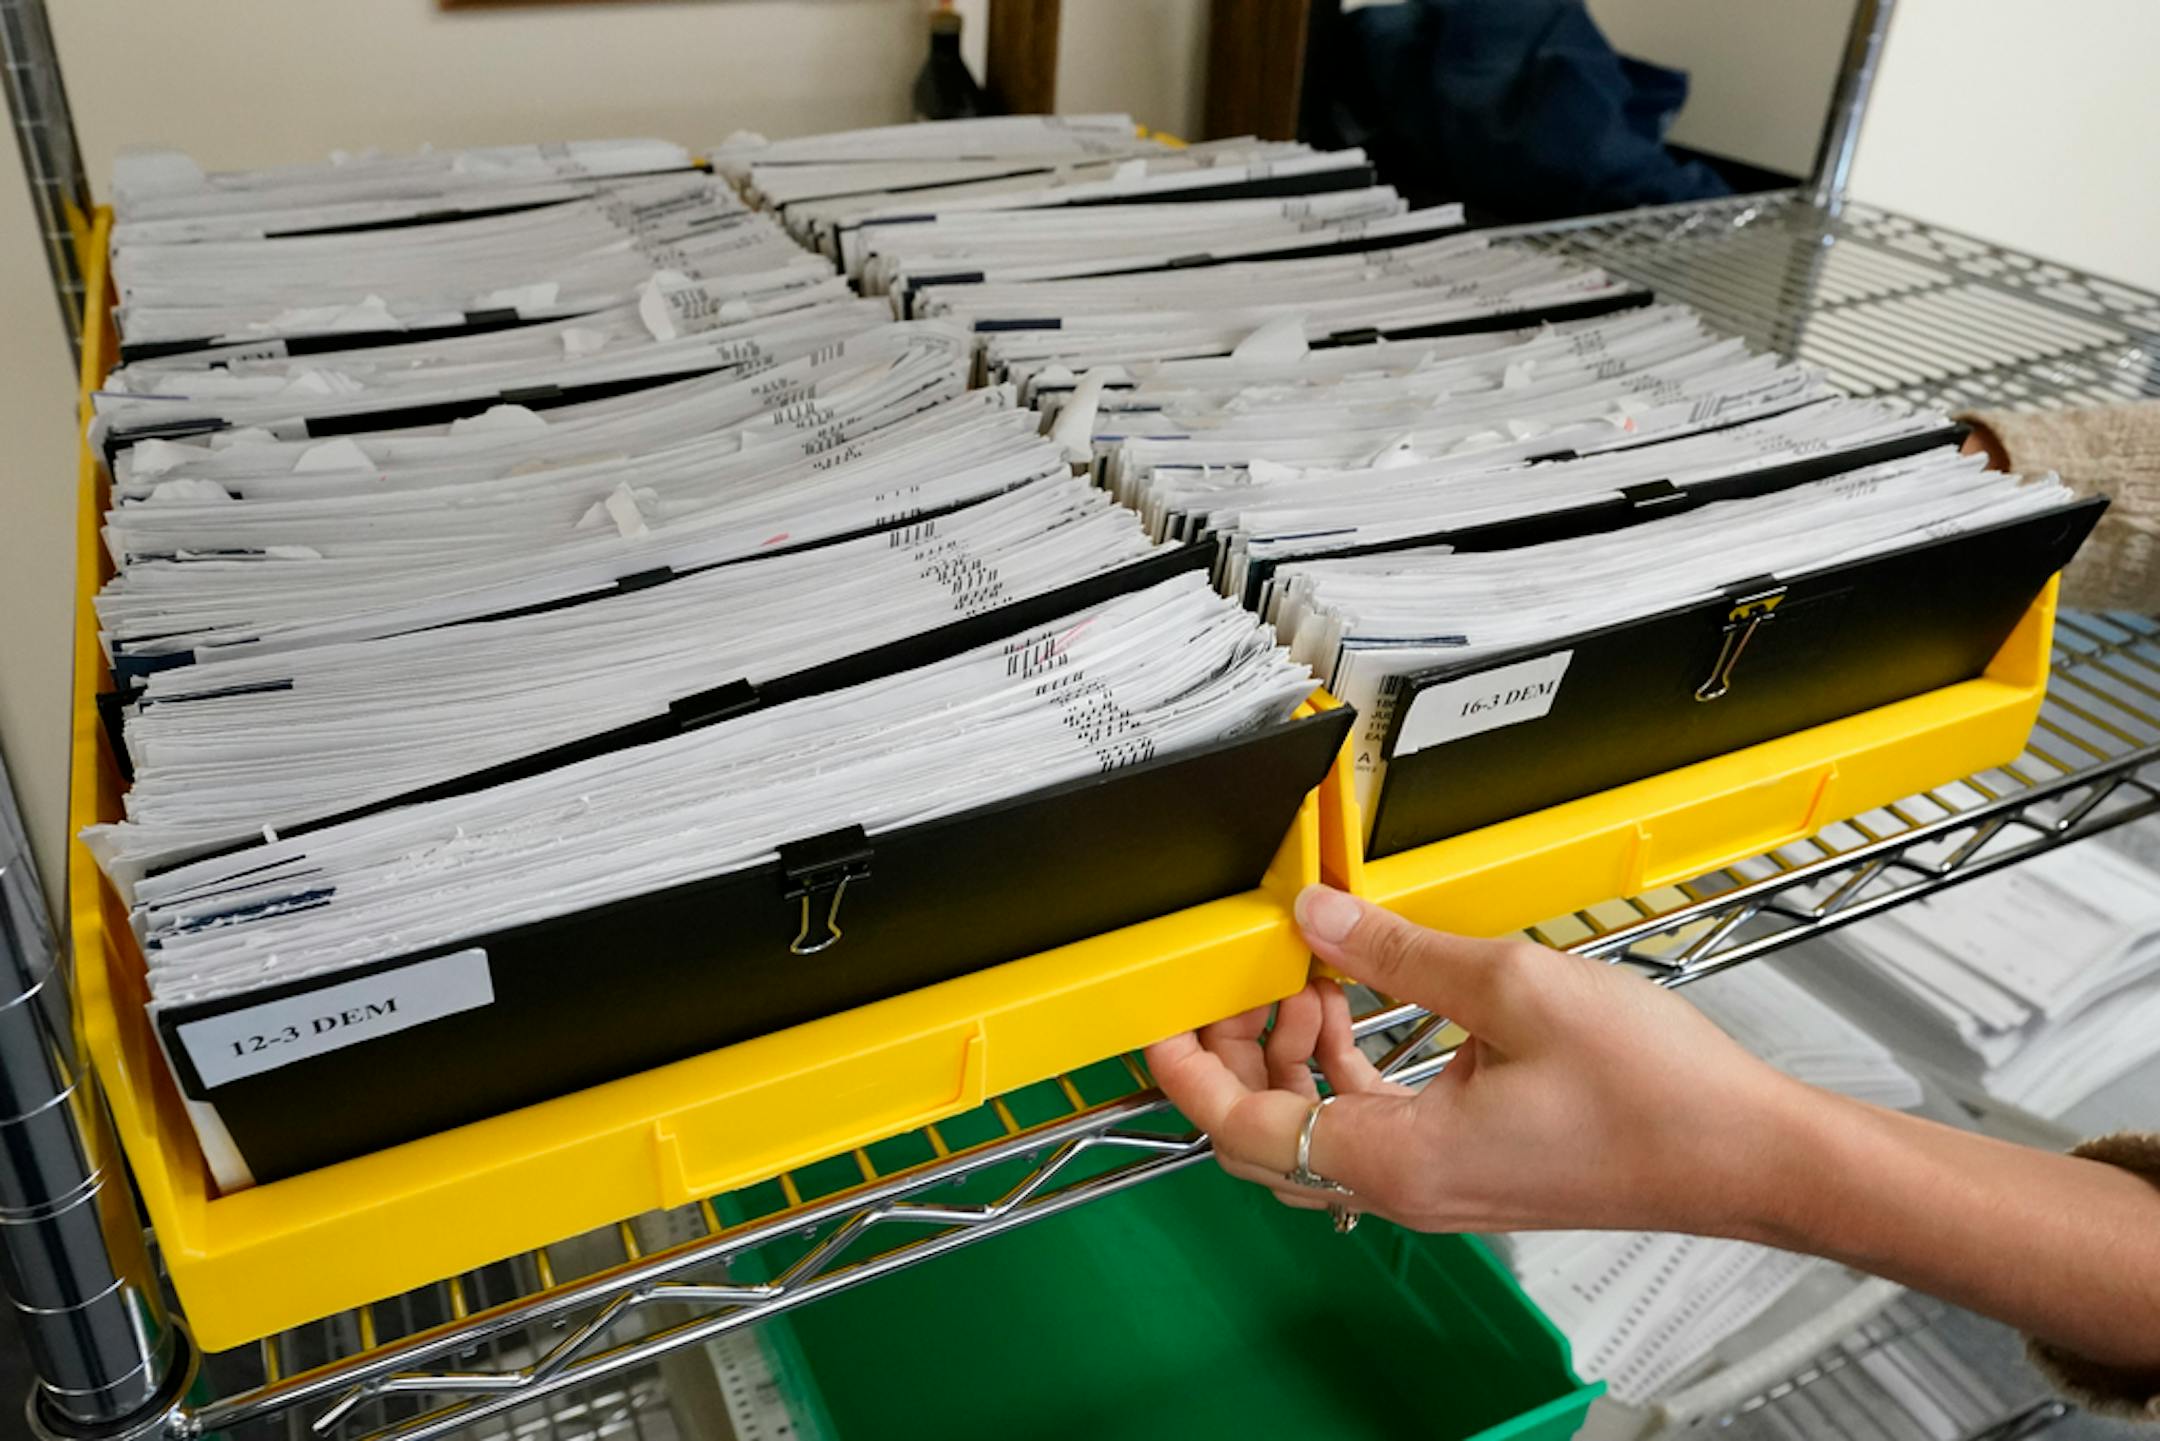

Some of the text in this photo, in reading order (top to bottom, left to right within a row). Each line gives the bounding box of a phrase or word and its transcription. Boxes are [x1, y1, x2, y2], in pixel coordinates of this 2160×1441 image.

[1461, 680, 1555, 717] 16-3 DEM
[230, 998, 398, 1057] 12-3 DEM
